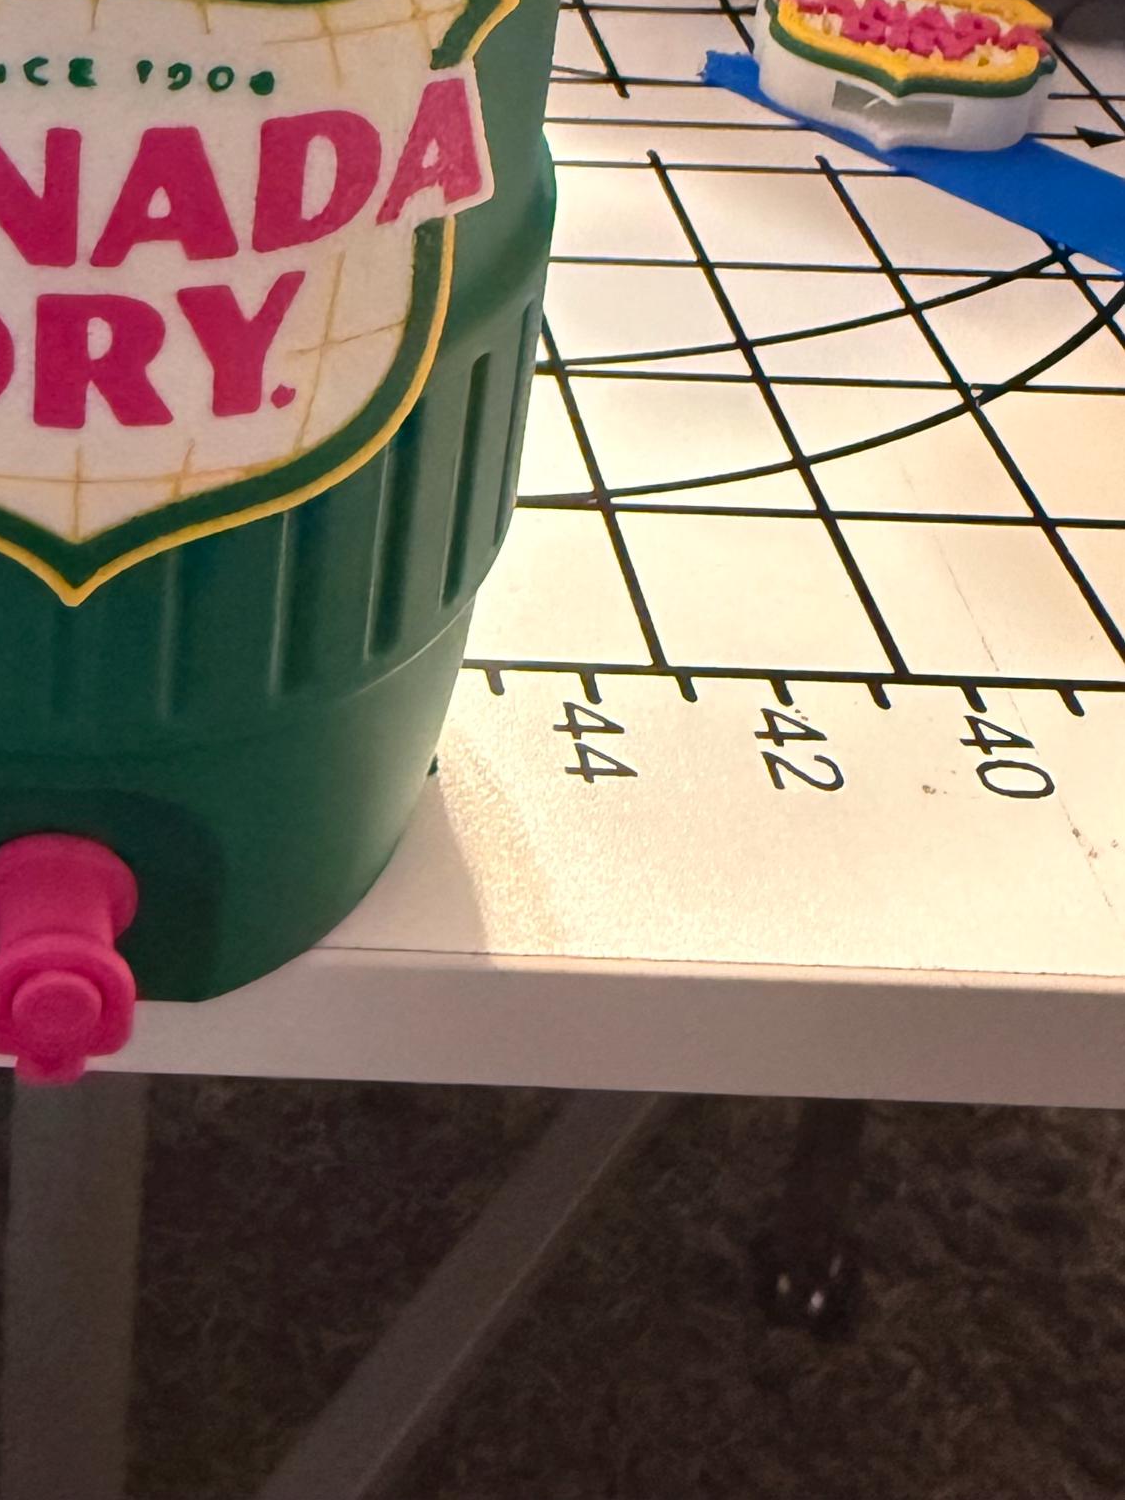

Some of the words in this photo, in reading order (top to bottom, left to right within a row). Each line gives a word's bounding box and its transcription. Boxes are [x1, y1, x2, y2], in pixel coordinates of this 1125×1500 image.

[553, 701, 639, 783] 44
[753, 707, 845, 792] 42
[959, 714, 1055, 799] 40
